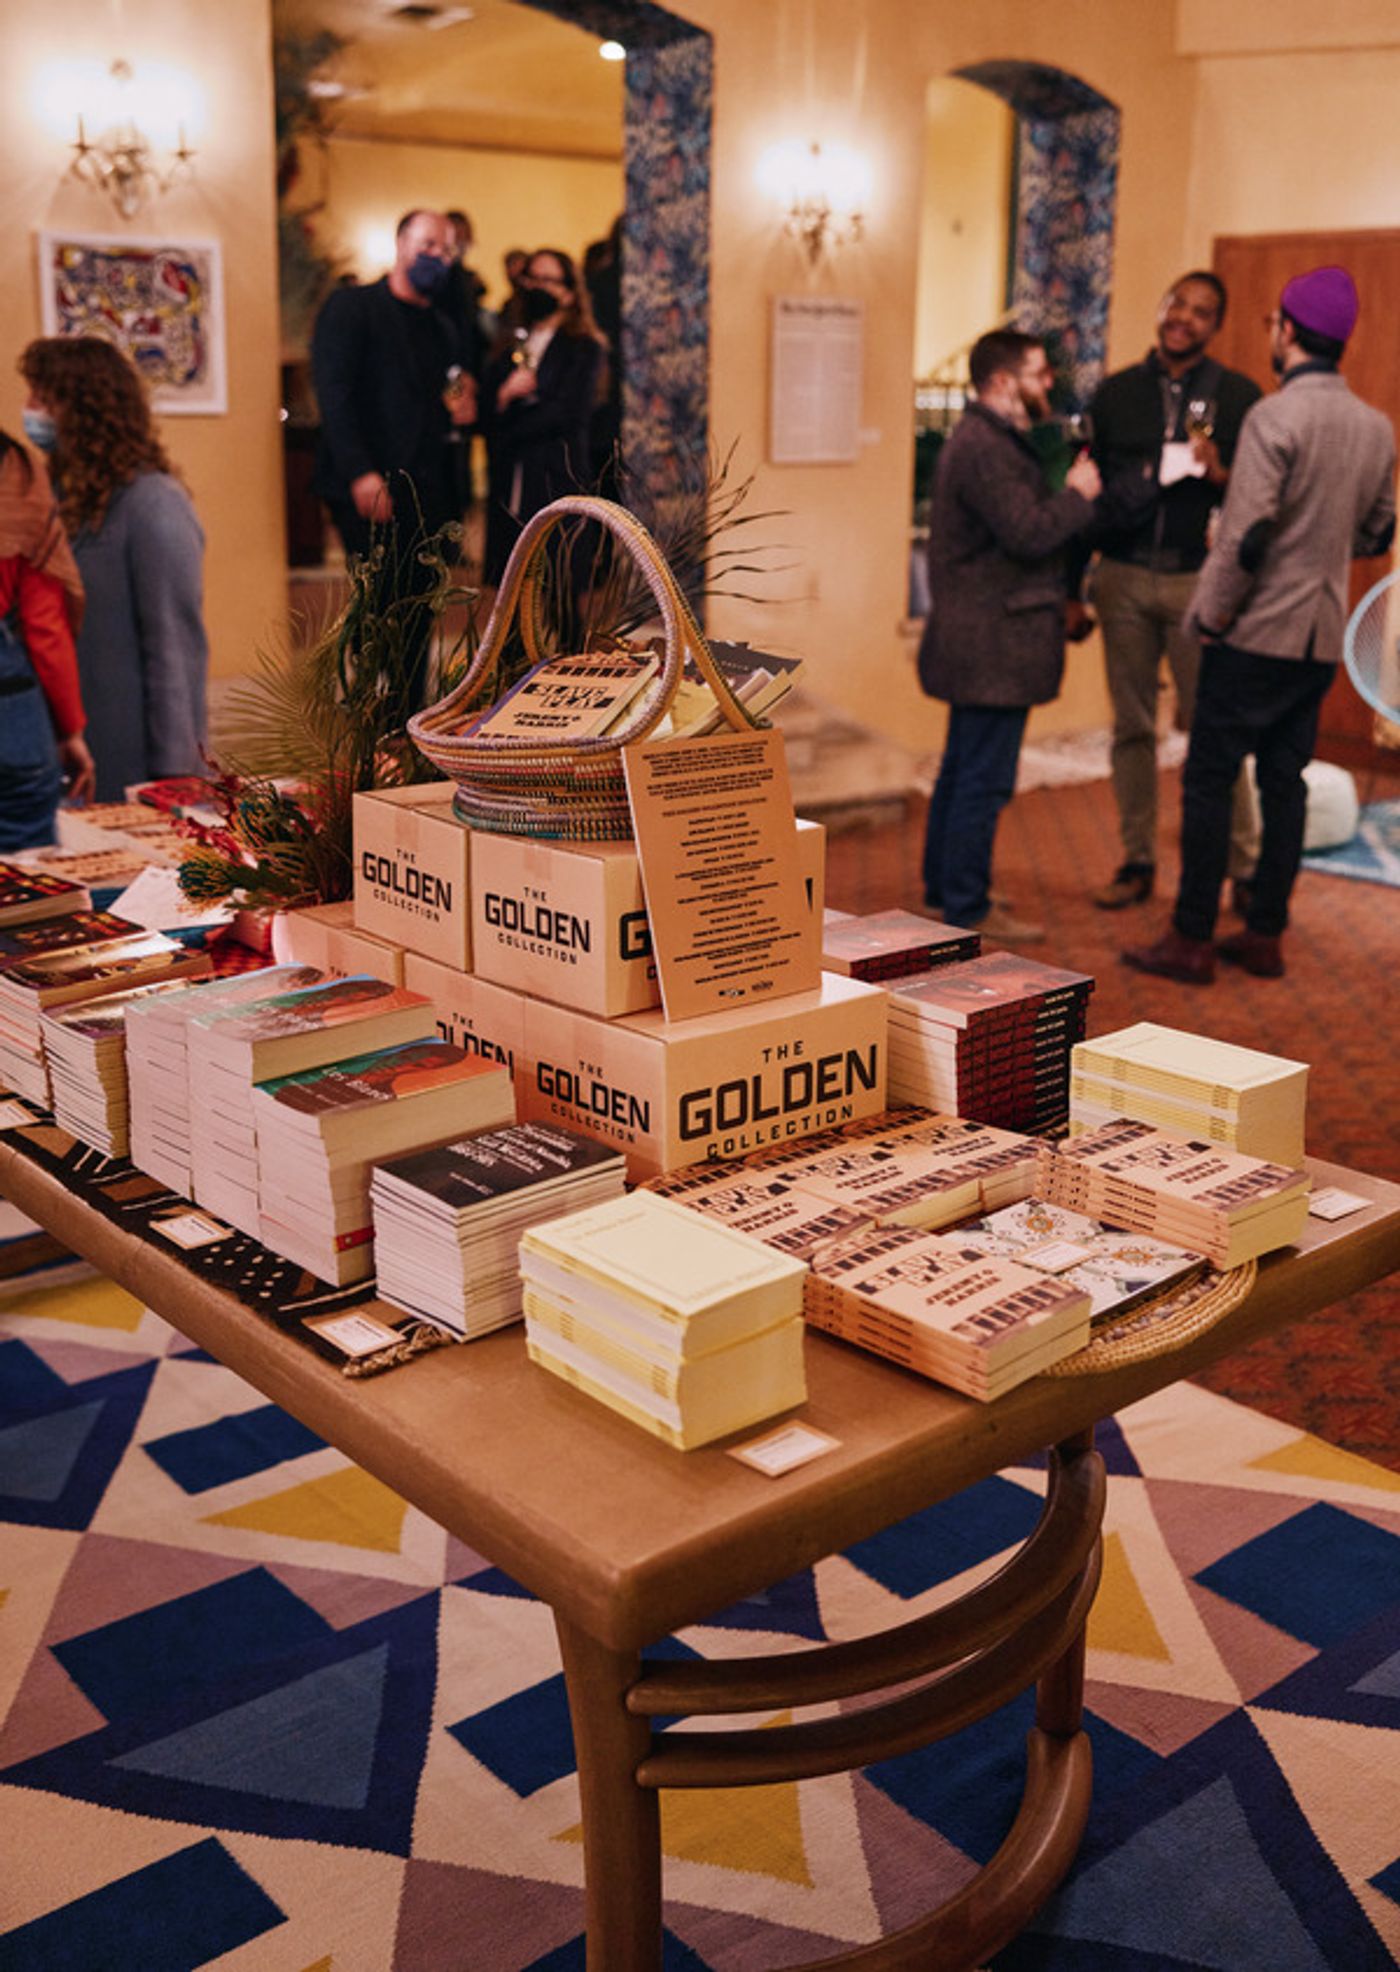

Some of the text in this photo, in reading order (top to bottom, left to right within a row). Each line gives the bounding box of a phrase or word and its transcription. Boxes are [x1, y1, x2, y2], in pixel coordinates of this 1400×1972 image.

[396, 848, 416, 865] THE
[362, 851, 452, 913] GOLDEN
[523, 886, 547, 902] THE
[373, 888, 441, 923] COLLECTION
[484, 892, 591, 953] GOLDEN
[498, 931, 578, 965] COLLECTION
[452, 1012, 474, 1028] THE
[436, 1020, 515, 1084] DEN
[578, 1059, 604, 1079] THE
[762, 1040, 804, 1064] THE
[536, 1061, 651, 1134] GOLDEN
[678, 1043, 878, 1142] GOLDEN
[550, 1102, 637, 1145] COLLECTION
[706, 1103, 854, 1159] COLLECTION
